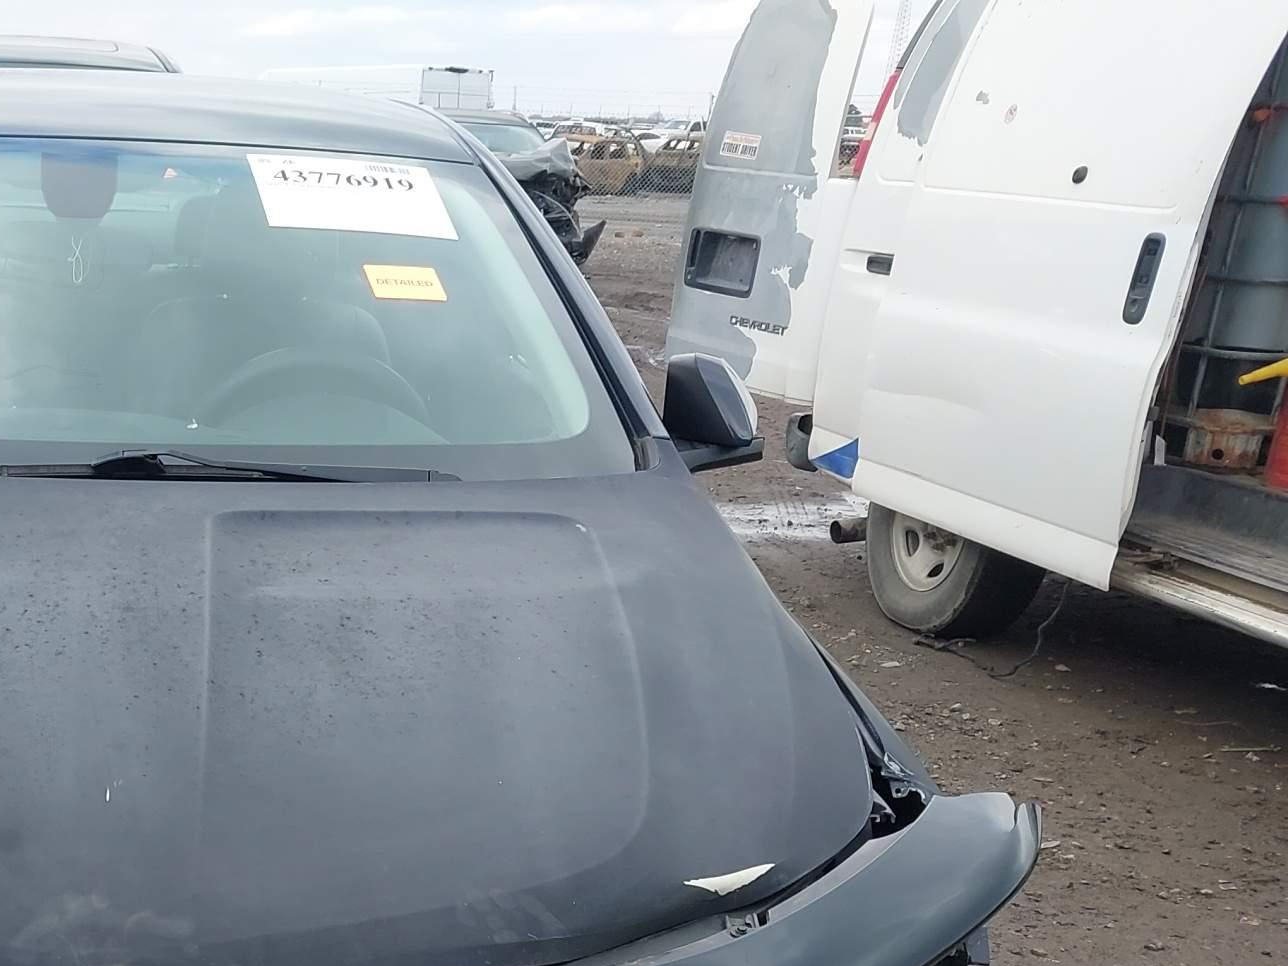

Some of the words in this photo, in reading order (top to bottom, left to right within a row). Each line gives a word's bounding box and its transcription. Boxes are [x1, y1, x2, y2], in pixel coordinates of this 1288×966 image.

[273, 169, 414, 191] 43776919
[375, 278, 433, 287] DETAILED
[729, 315, 788, 336] CHEVROLET
